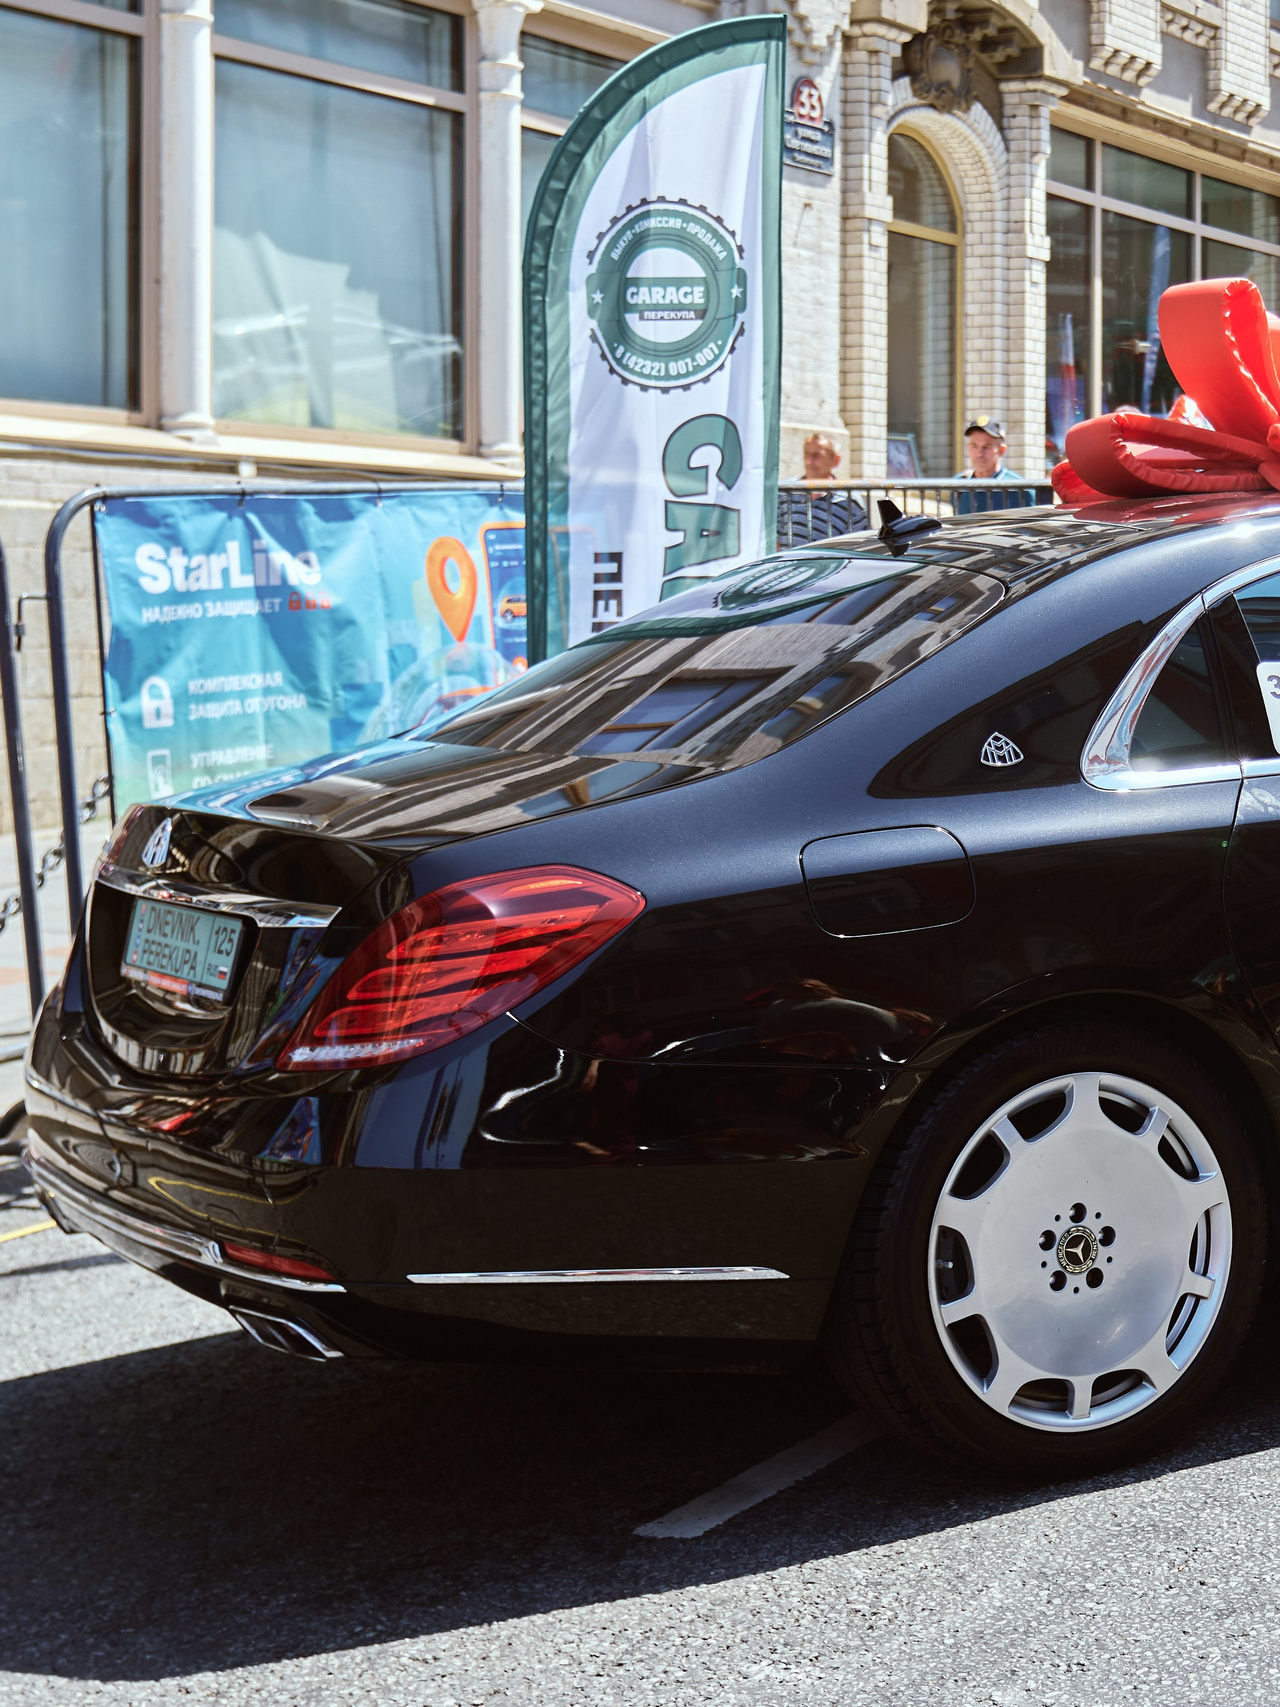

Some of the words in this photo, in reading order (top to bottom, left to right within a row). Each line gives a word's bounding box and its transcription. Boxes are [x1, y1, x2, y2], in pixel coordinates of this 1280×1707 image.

[799, 86, 820, 119] 33
[610, 231, 633, 261] ВЫКУП
[634, 216, 683, 234] КОМИССИЯ
[687, 222, 727, 261] ПРОДАЖА
[626, 286, 705, 304] GARAGE
[643, 311, 696, 320] ПЕРЕКУПА
[615, 346, 624, 359] 8
[623, 350, 665, 376] (4232)
[668, 342, 720, 376] 007-007
[135, 540, 322, 594] StarLine
[141, 602, 203, 625] НАДЕЖНО
[205, 598, 283, 619] ЗАЩИЩАЕТ
[187, 671, 283, 695] КОМПЛЕКСНАЯ
[188, 699, 243, 721] ЗАЩИТА
[262, 693, 307, 712] УГОНА
[191, 744, 275, 769] УПРАВЛЕНИЕ
[146, 906, 201, 946] DNEVNIK.
[213, 926, 237, 957] 125
[141, 939, 198, 979] PEREKUPA
